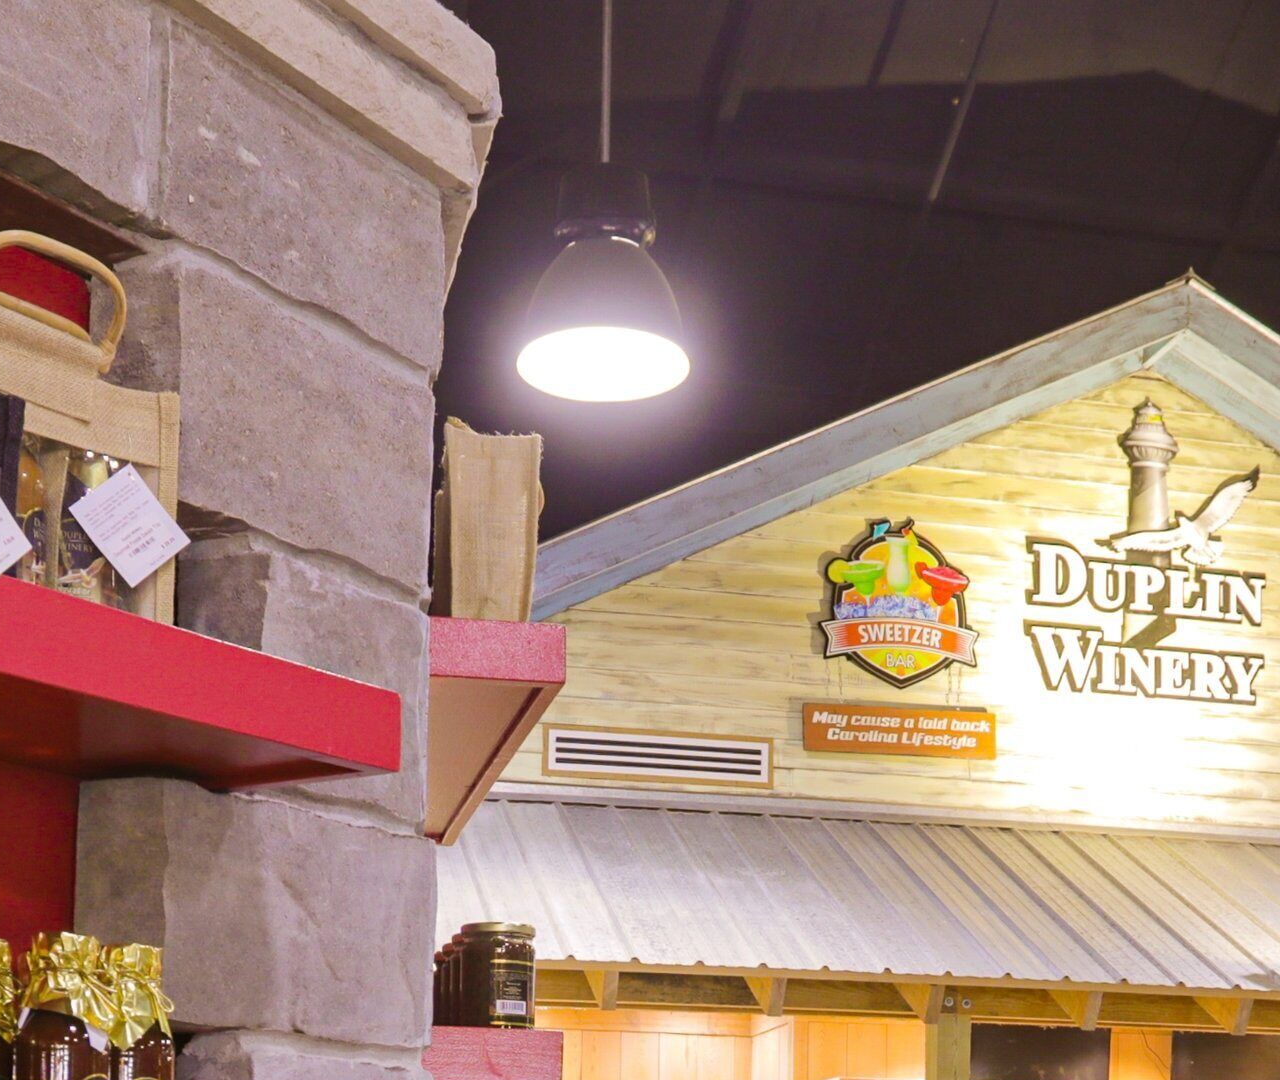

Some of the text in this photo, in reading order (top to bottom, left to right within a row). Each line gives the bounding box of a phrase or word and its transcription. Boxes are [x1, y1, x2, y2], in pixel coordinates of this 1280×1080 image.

[1030, 542, 1265, 624] DUPLIN
[857, 623, 943, 648] SWEETZER
[886, 653, 915, 669] BAR
[1030, 625, 1264, 702] WINERY
[812, 711, 990, 733] May cause a laid back
[826, 727, 977, 750] Carolina Lifestyle
